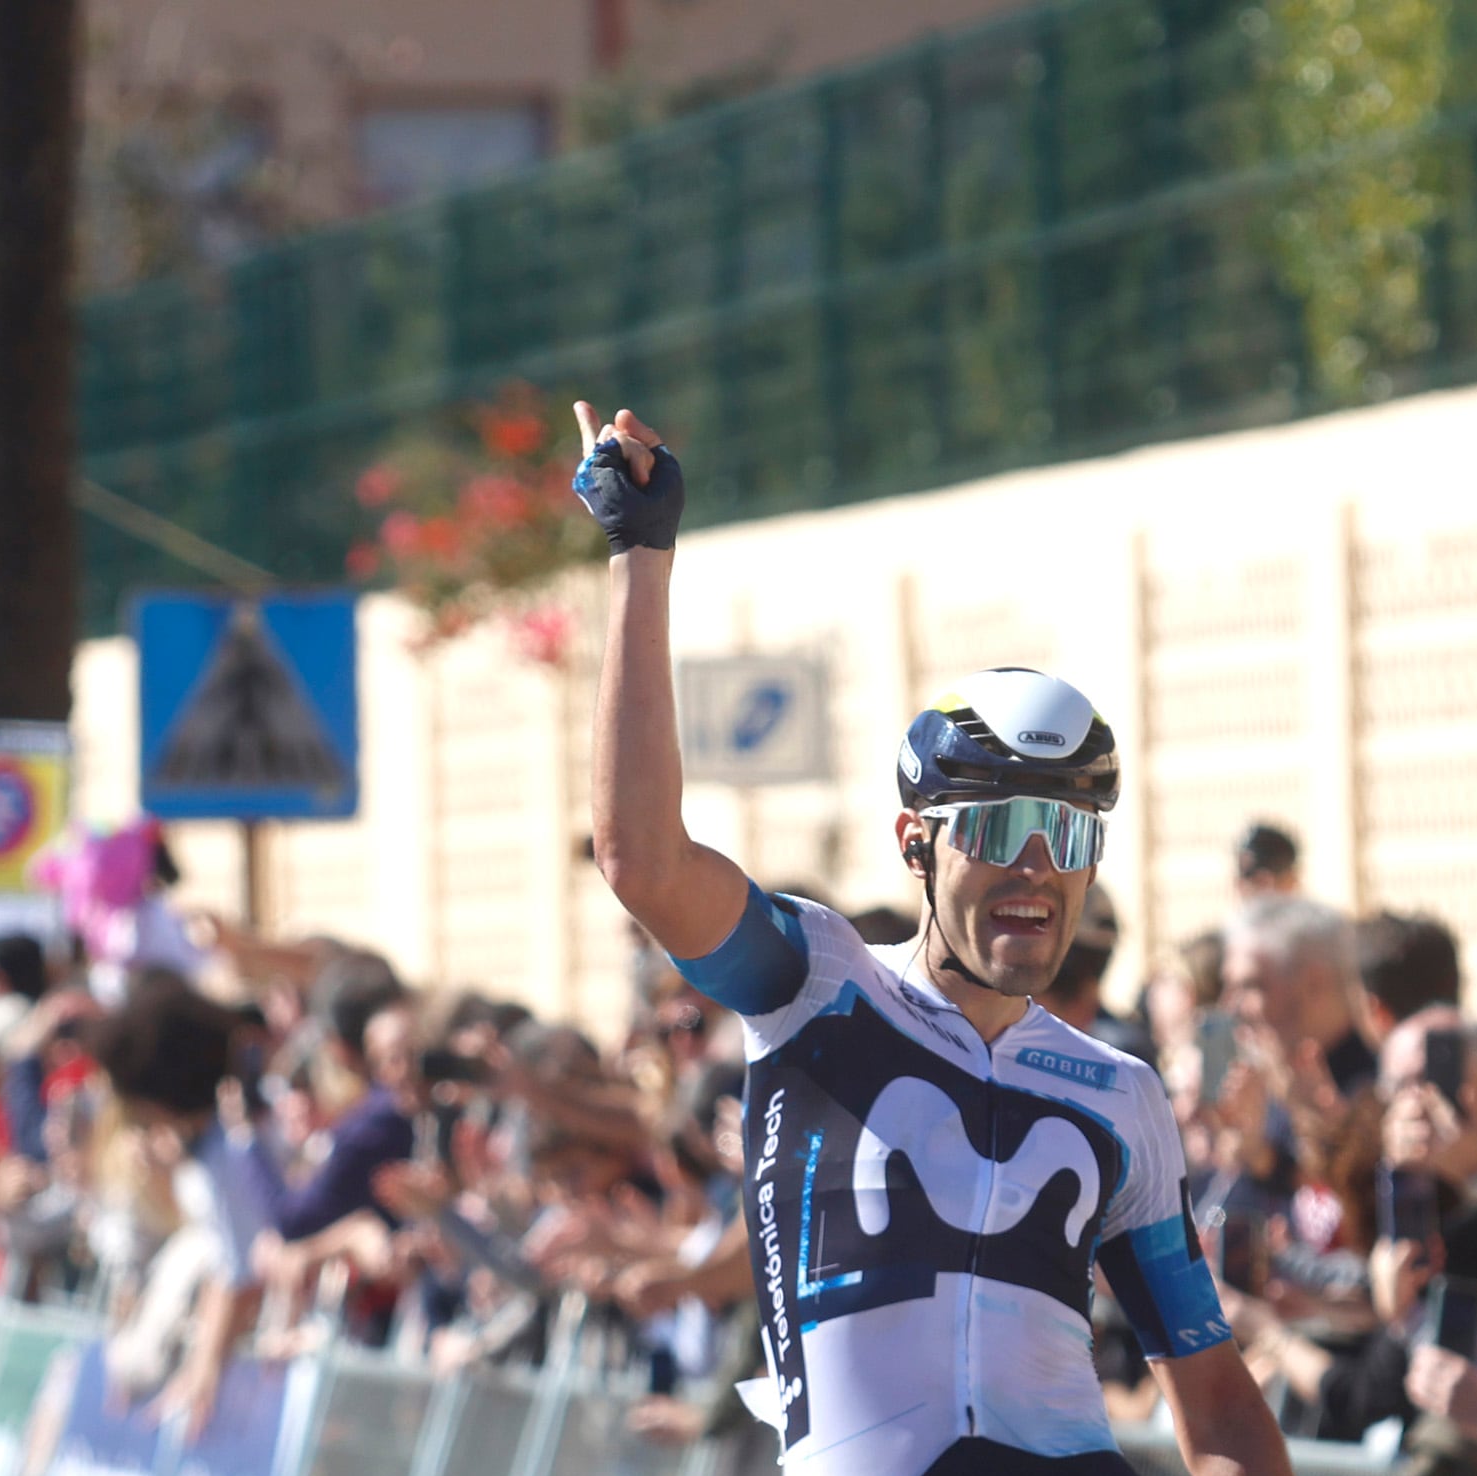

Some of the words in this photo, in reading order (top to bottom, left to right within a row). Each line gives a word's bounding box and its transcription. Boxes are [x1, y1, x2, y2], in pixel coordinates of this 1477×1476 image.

[1025, 1050, 1098, 1081] GOBIK
[754, 1088, 786, 1181] Tech
[757, 1180, 791, 1363] Telefónica
